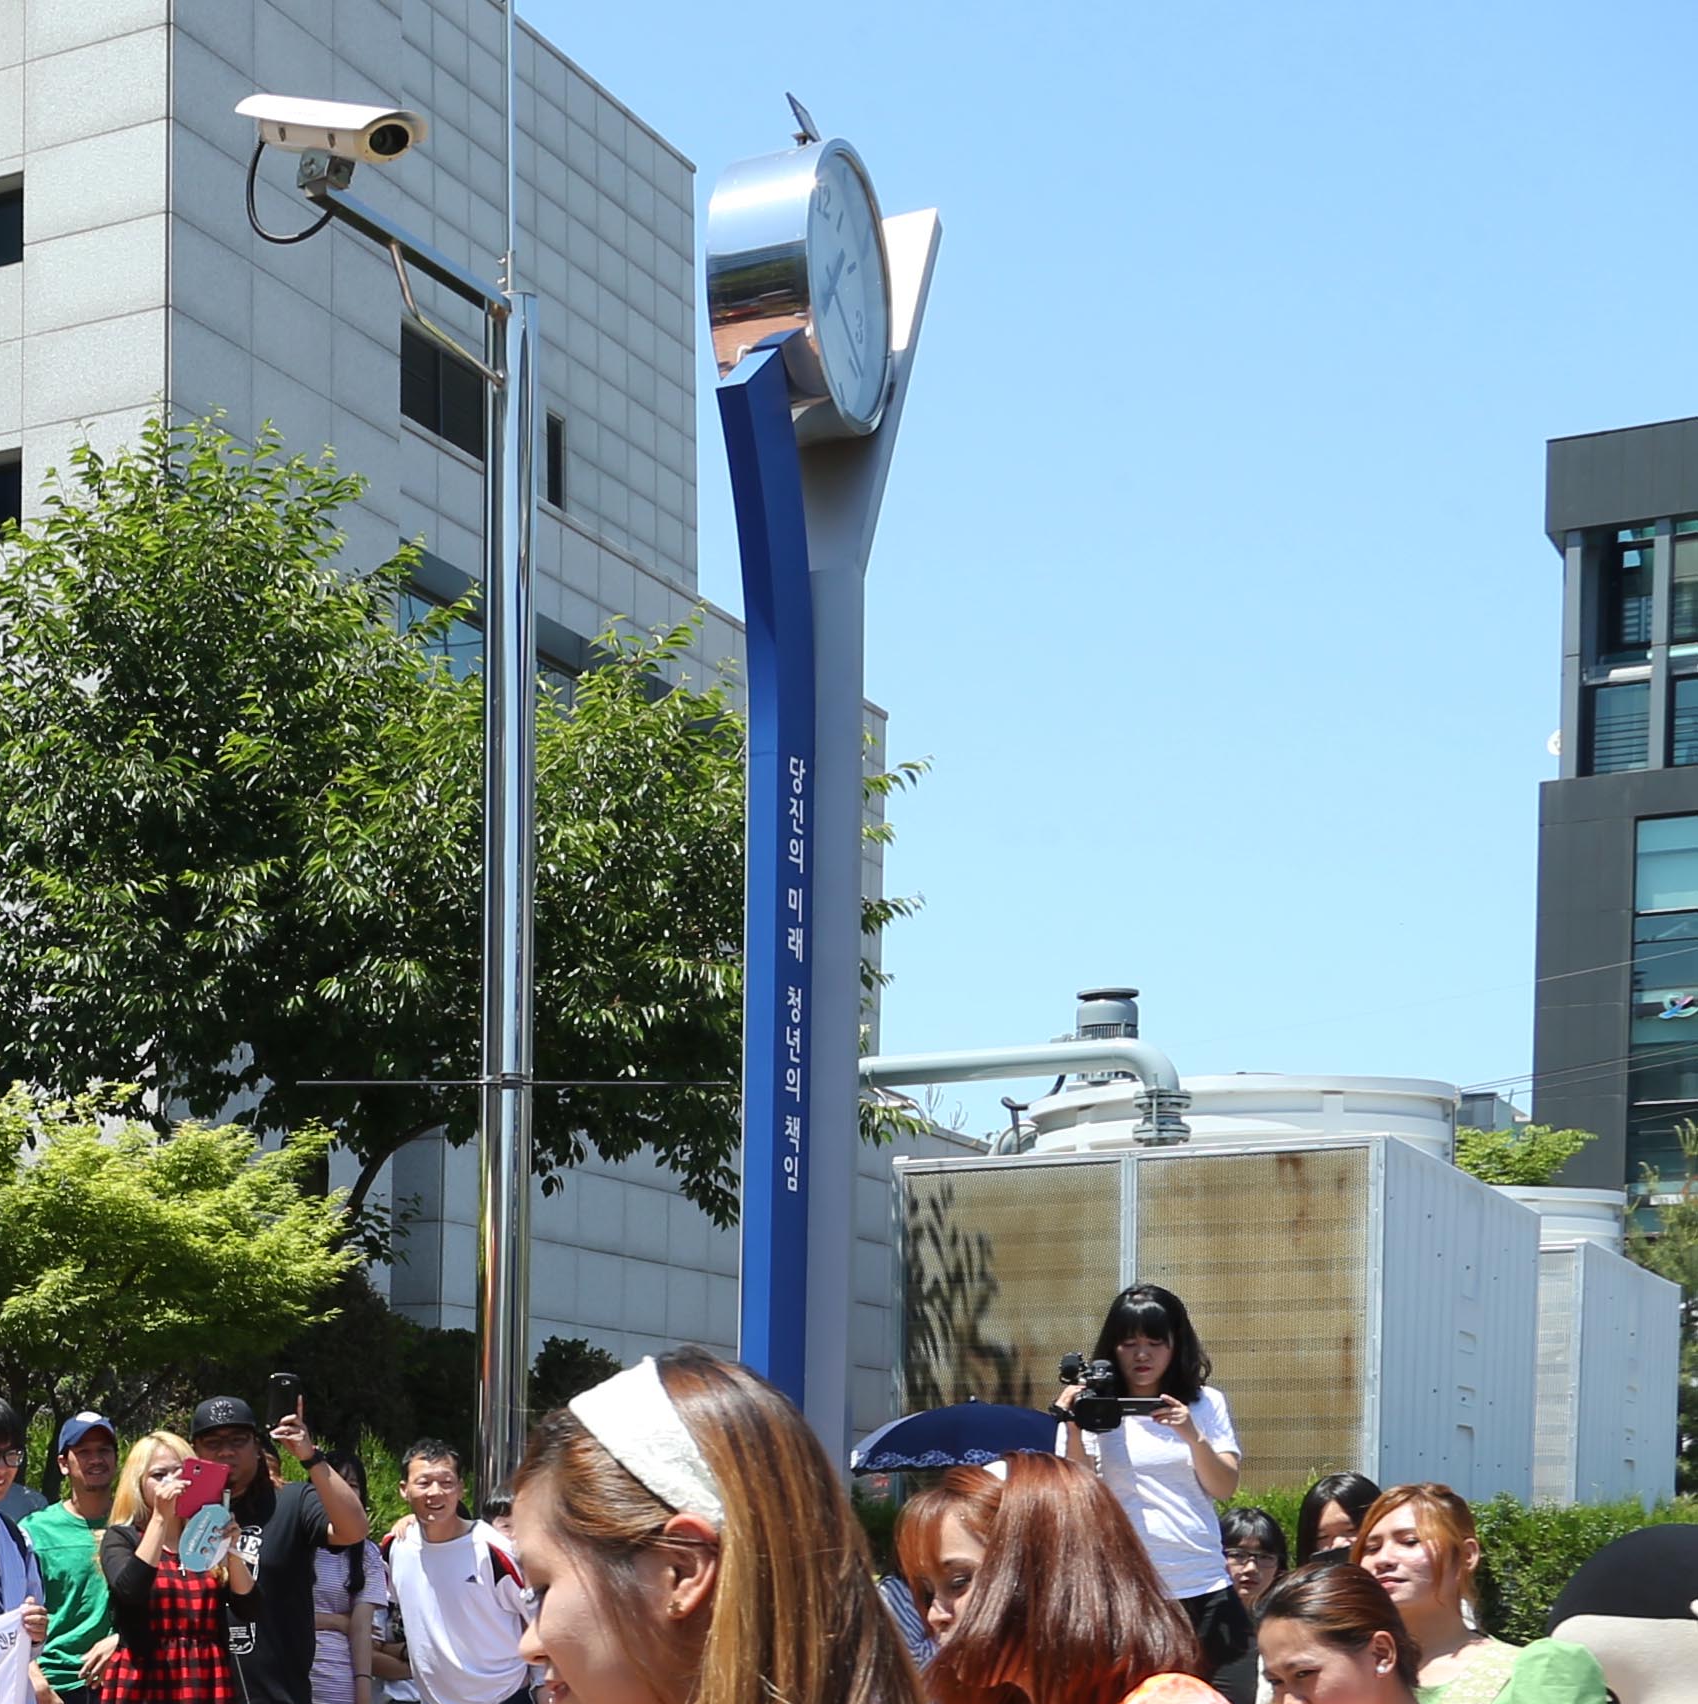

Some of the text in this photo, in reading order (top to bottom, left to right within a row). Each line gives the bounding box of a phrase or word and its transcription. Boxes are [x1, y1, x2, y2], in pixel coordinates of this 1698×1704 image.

[783, 754, 807, 1193] 당진의 미래 청년의 책임
